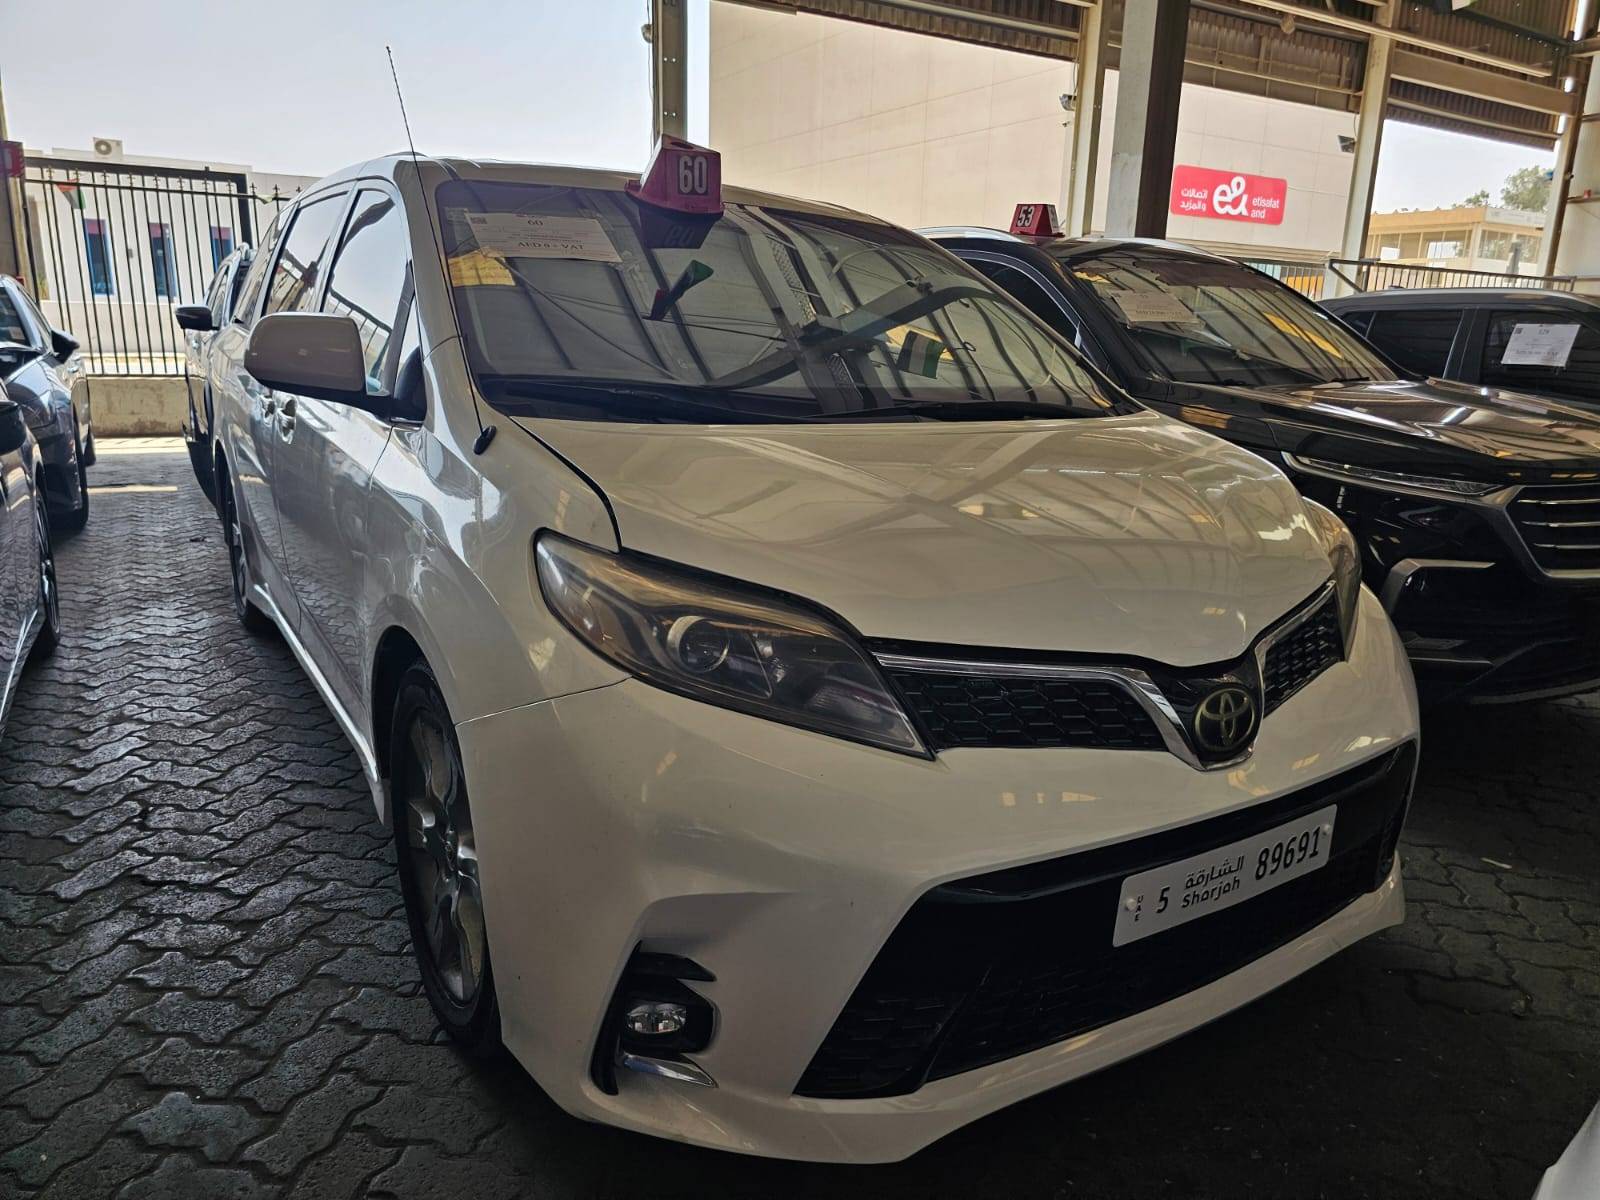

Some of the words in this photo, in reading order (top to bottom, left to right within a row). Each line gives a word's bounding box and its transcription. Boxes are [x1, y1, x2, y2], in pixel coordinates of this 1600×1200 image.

[679, 155, 708, 194] 60
[1181, 188, 1208, 200] اتصالات
[1252, 197, 1280, 208] etisalat
[1017, 206, 1035, 226] 53
[1180, 200, 1207, 212] والمزيد
[1250, 209, 1266, 219] and
[1255, 826, 1321, 881] 89691
[1185, 856, 1244, 888] الشارقة
[1156, 887, 1170, 914] 5
[1182, 876, 1240, 909] Sharjah
